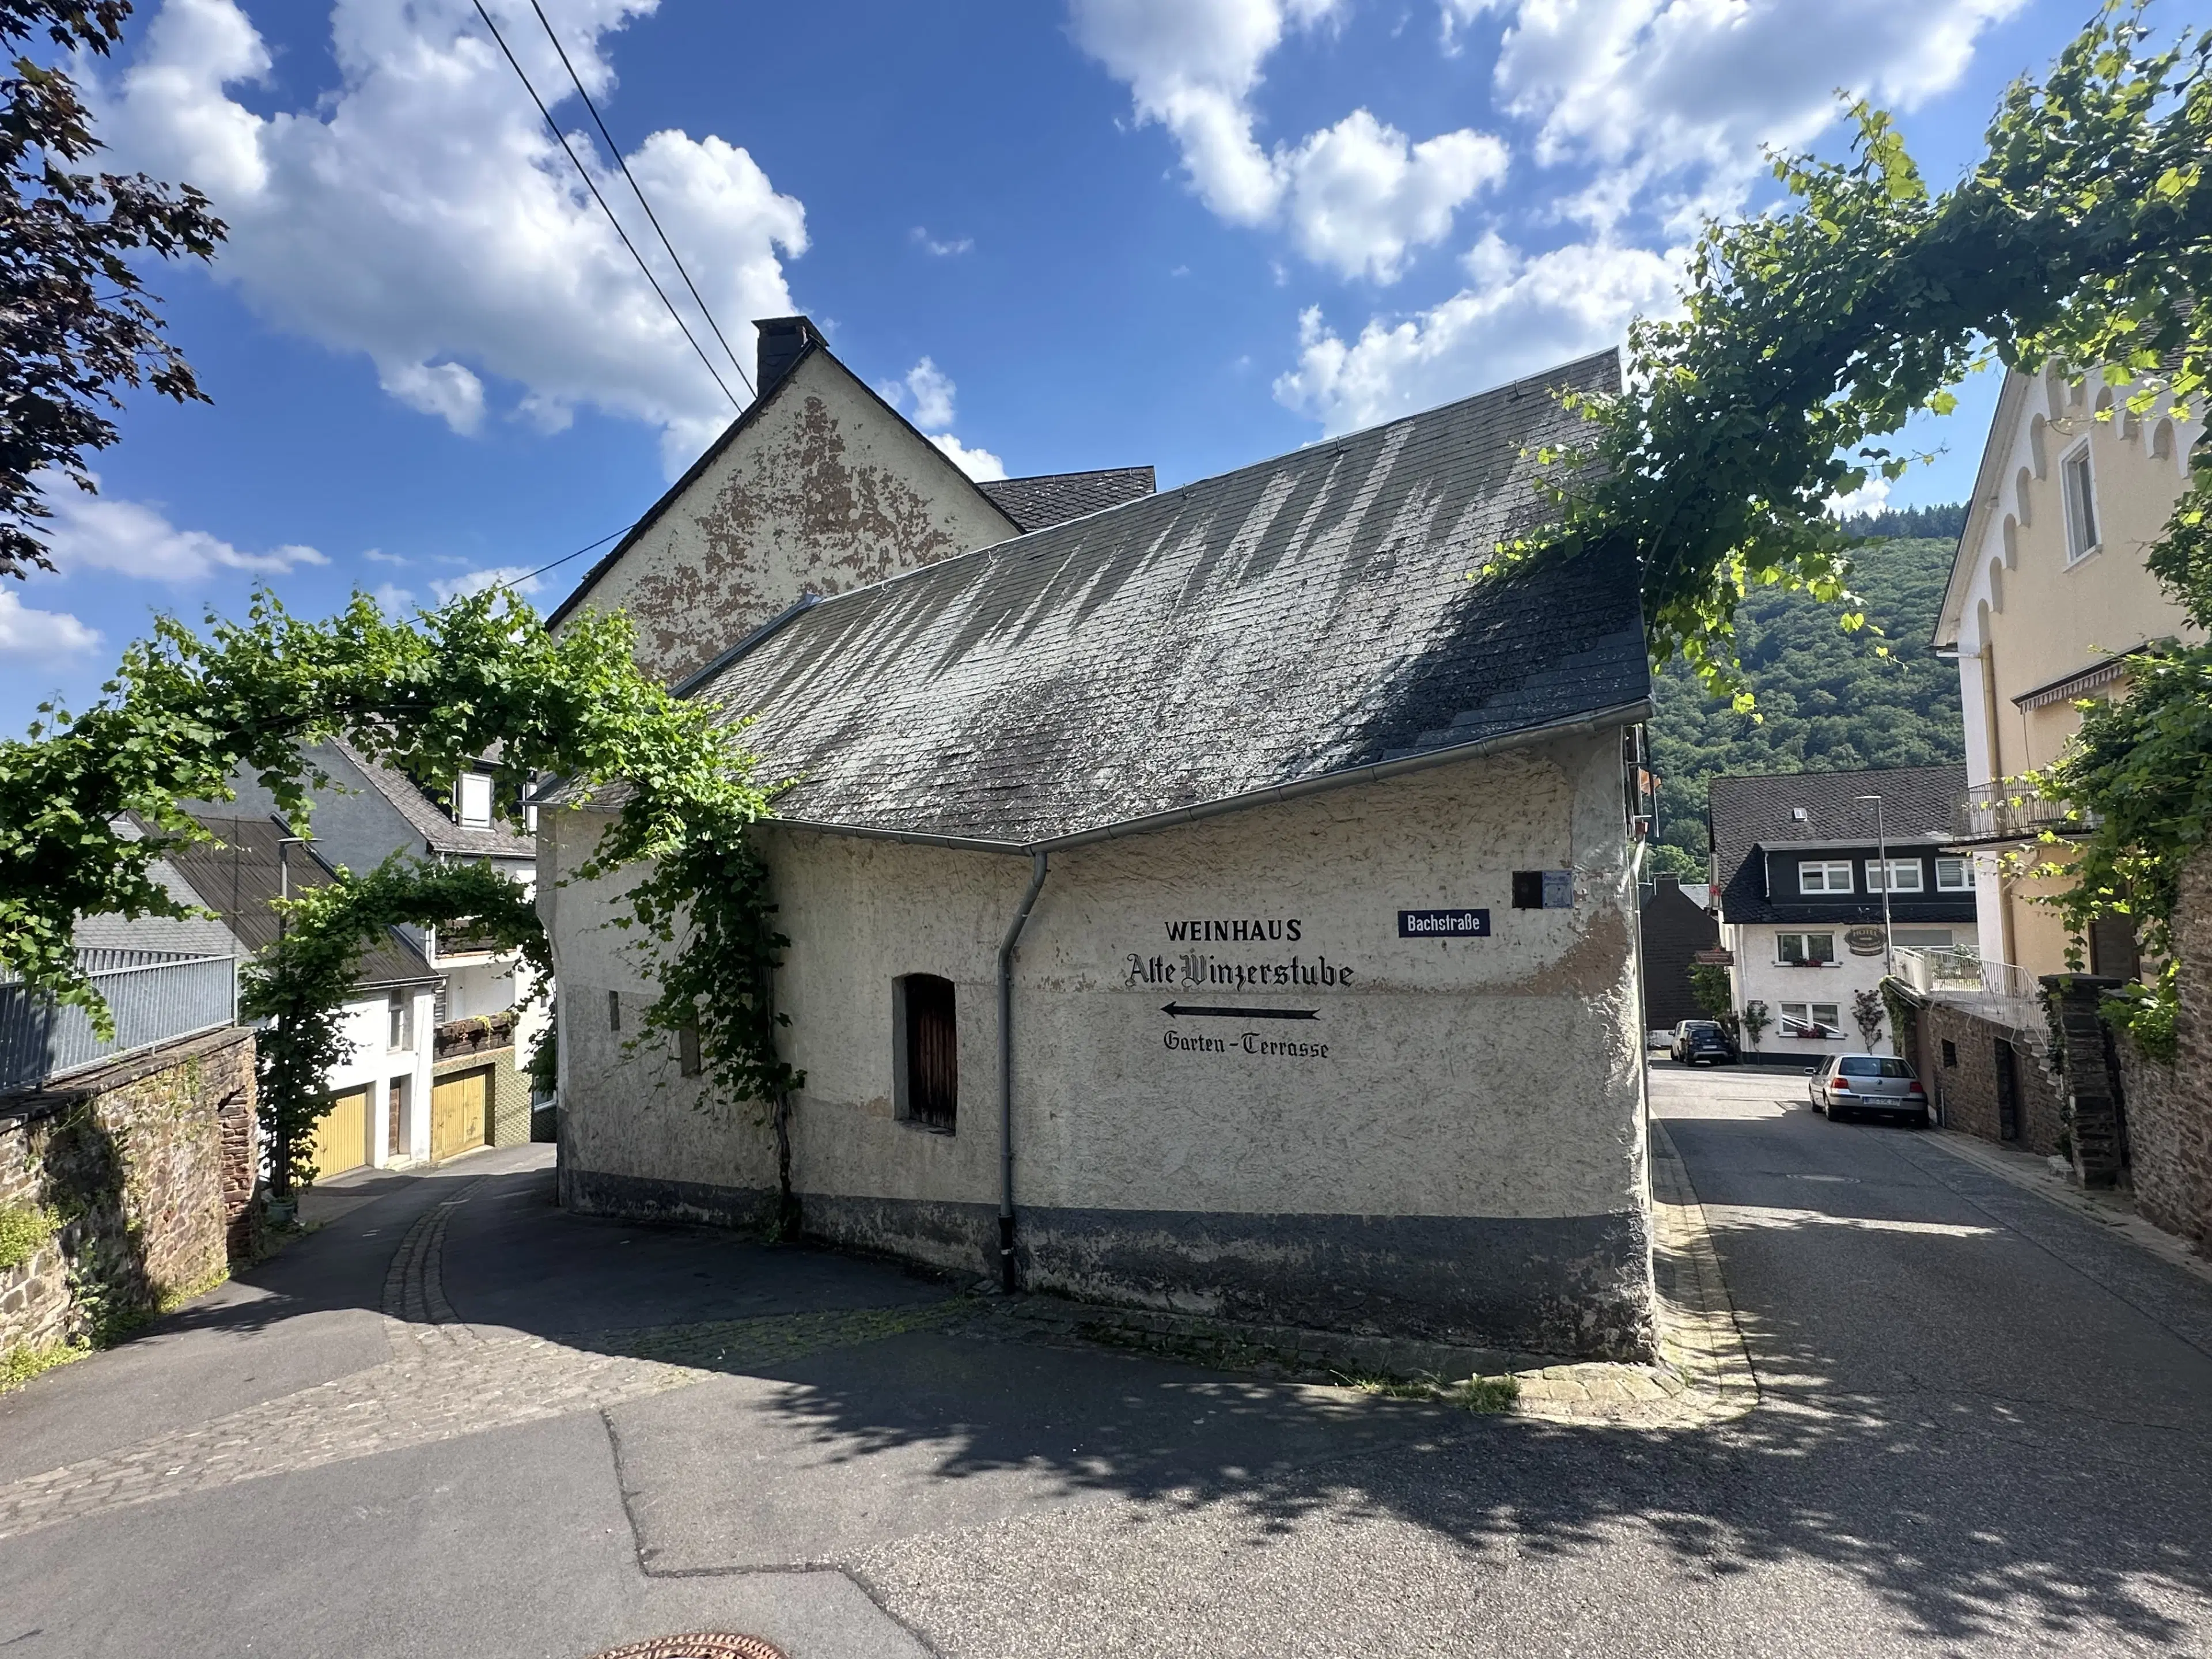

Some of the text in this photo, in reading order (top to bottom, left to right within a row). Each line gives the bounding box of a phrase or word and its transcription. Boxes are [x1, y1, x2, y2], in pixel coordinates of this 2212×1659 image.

[1164, 919, 1302, 942] WEINHAUS
[1407, 913, 1480, 932] Bachstraße
[1125, 953, 1354, 992] Alte Winzerstube
